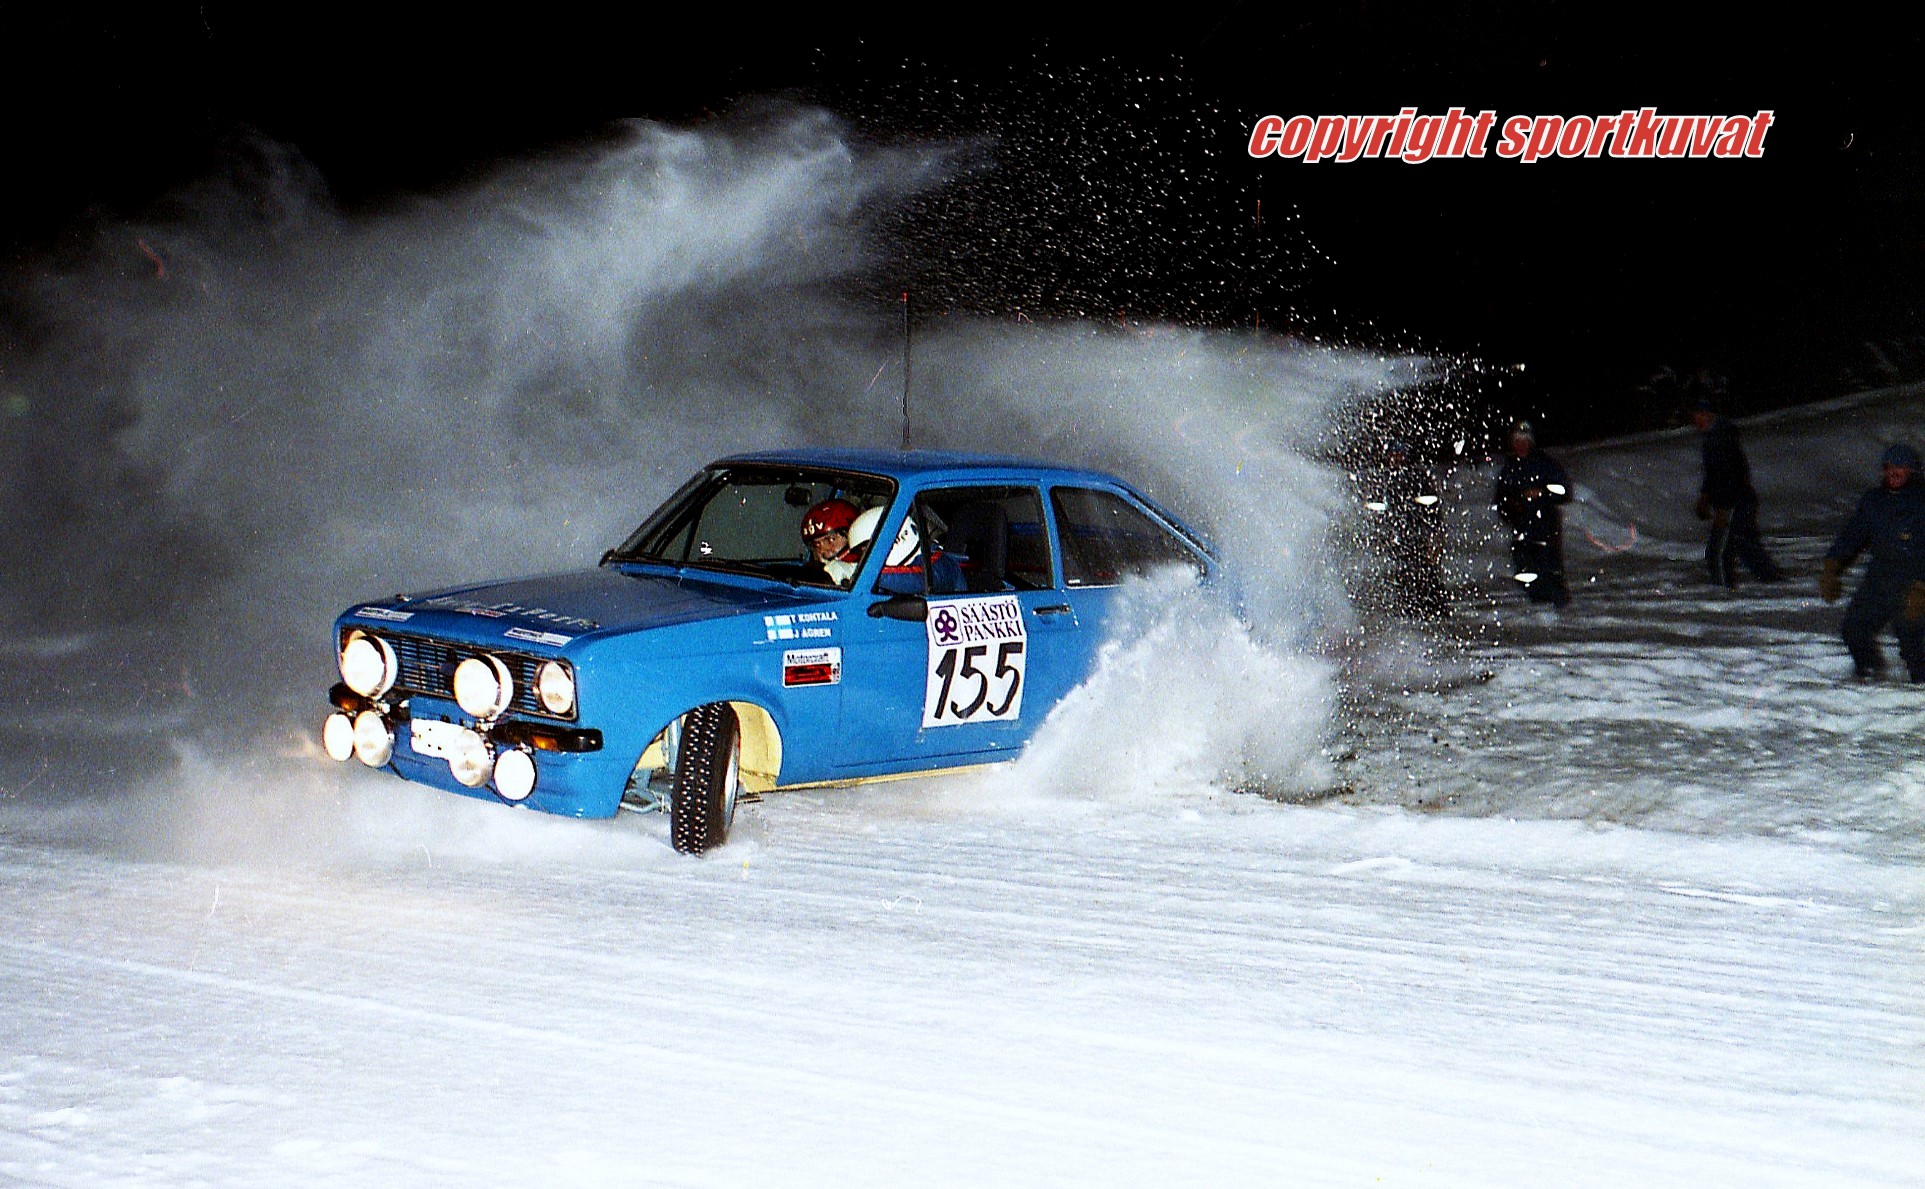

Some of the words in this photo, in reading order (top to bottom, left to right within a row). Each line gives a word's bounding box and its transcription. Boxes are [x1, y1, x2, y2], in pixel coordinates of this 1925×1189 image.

[961, 600, 1017, 624] SÄÄSTÖ
[964, 621, 1022, 641] PANKKI
[935, 642, 1023, 720] 155
